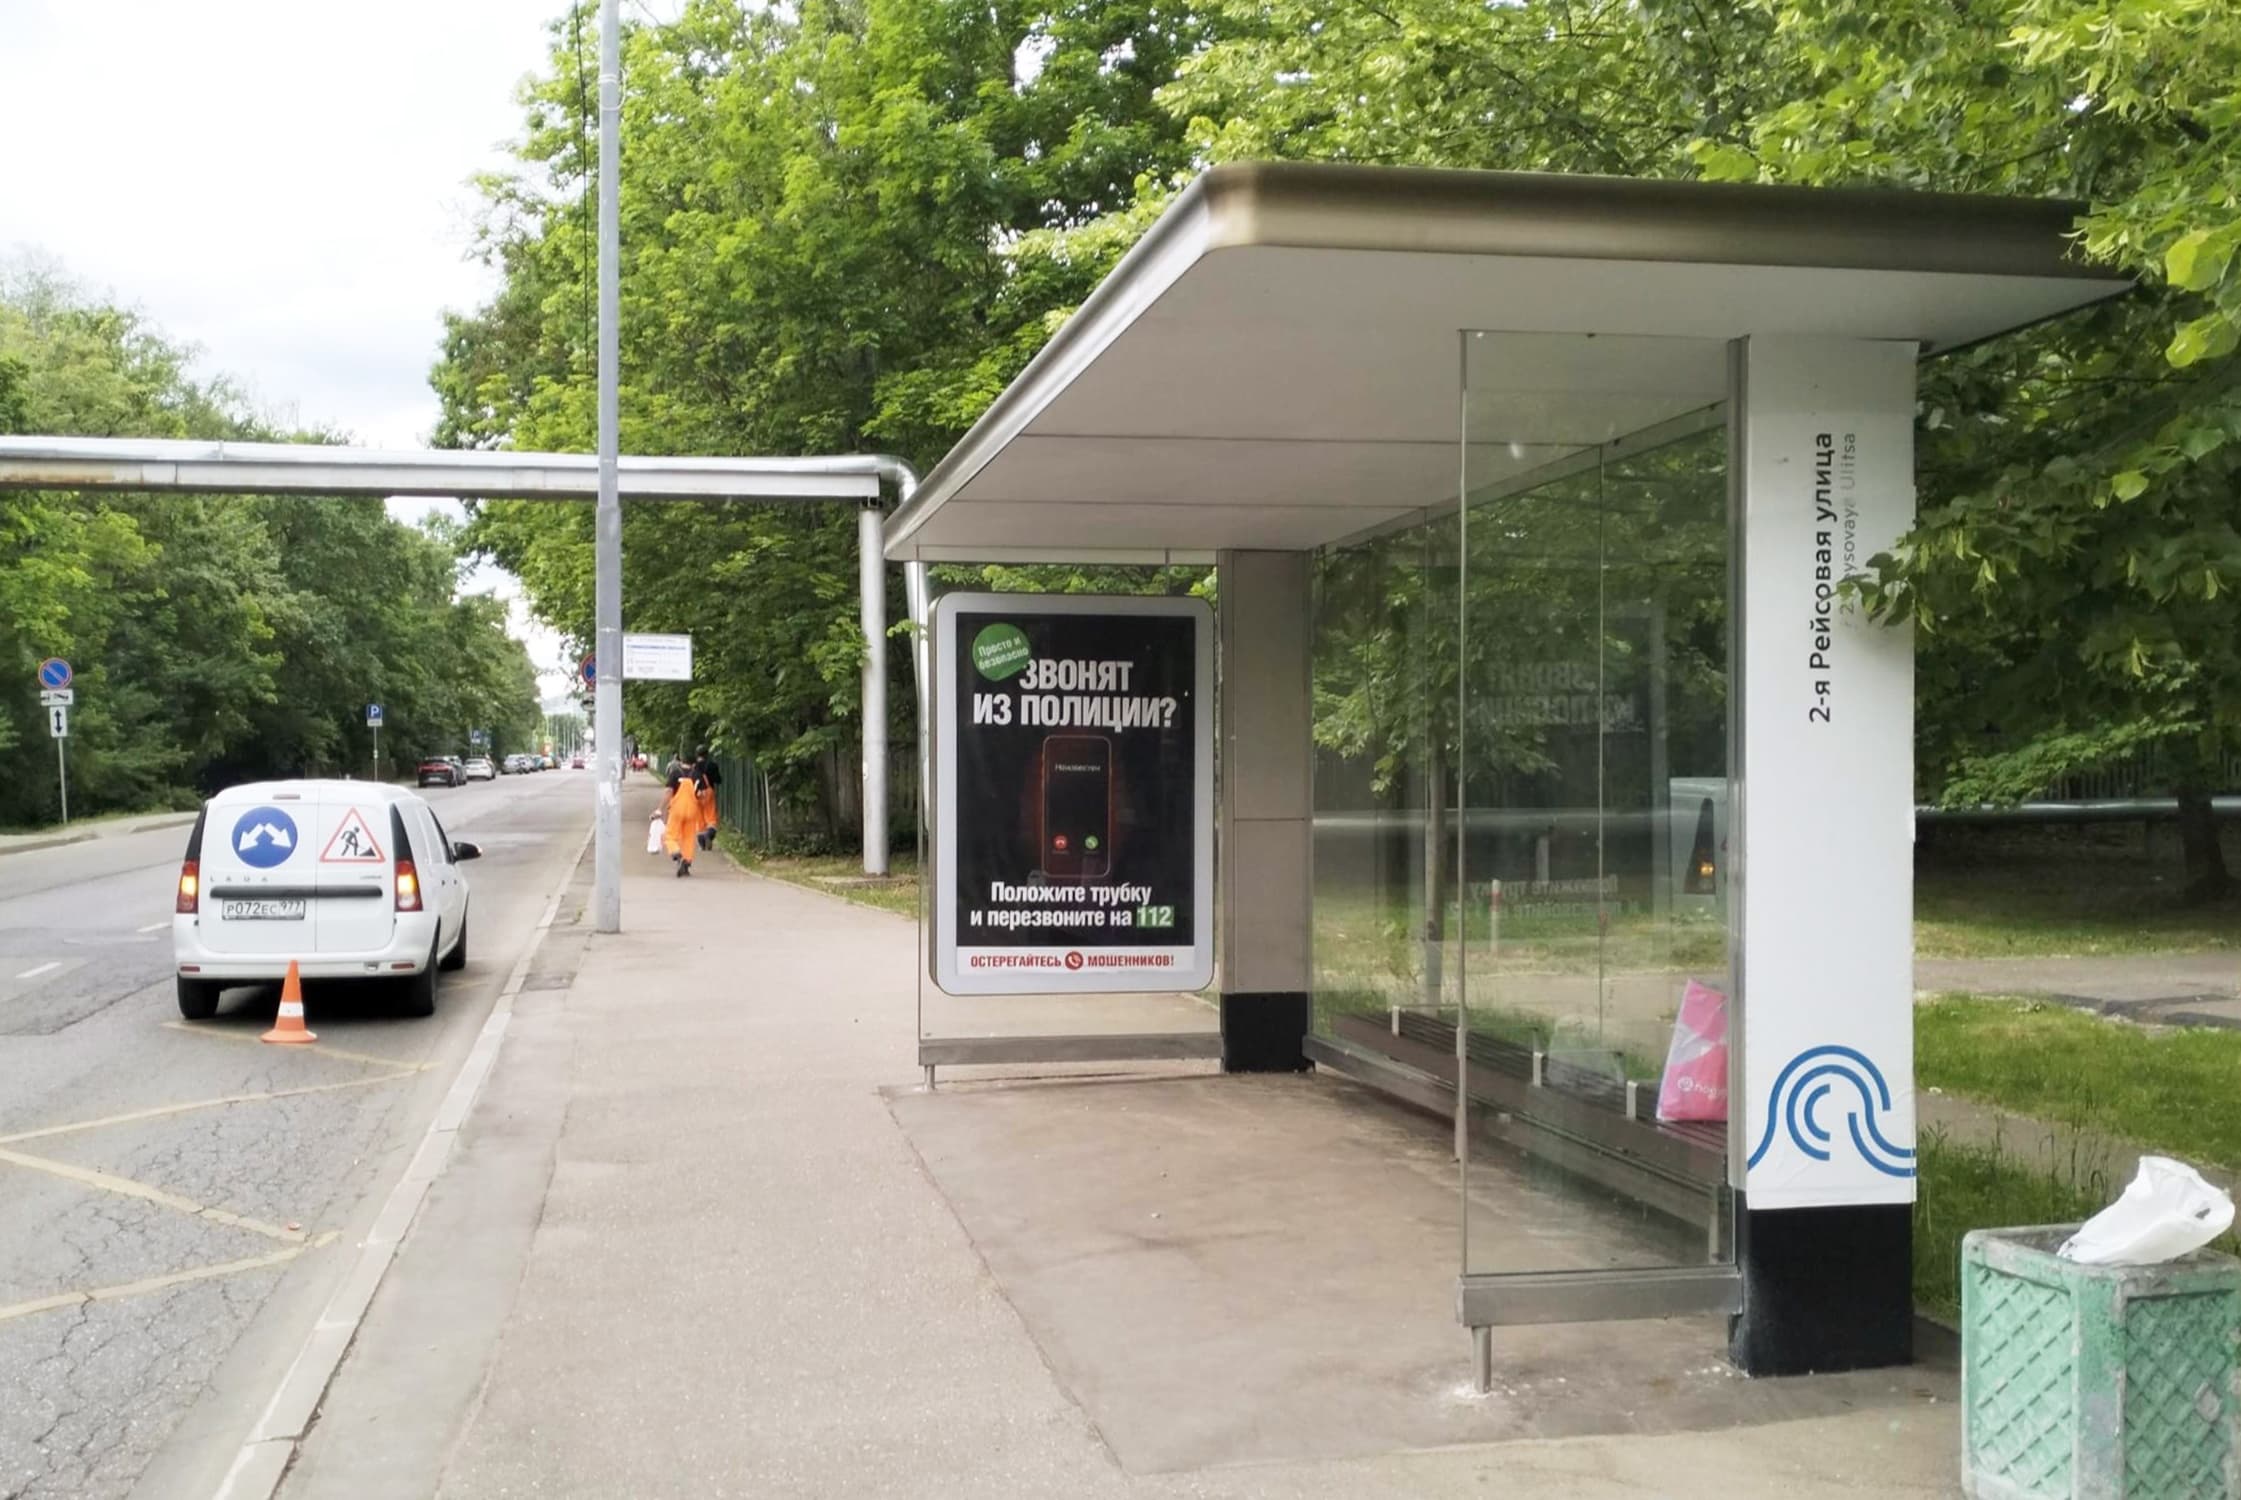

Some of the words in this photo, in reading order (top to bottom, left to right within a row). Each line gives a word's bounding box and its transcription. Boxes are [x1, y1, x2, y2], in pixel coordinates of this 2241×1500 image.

[1815, 432, 1838, 523] улица
[1809, 531, 1832, 669] Рейсовая
[977, 638, 1013, 657] Просто
[1019, 658, 1134, 692] ЗВОНЯТ
[973, 692, 1013, 726] ИЗ
[1020, 694, 1177, 733] ПОЛИЦИИ?
[1809, 680, 1831, 723] 2-я
[991, 881, 1086, 903] Положите
[1089, 882, 1153, 907] трубку
[970, 909, 983, 926] и
[987, 909, 1105, 931] перезвоните
[1109, 909, 1133, 926] на
[1137, 905, 1173, 927] 112
[970, 953, 1062, 968] ОСТЕРЕГАЙТЕСЬ
[1087, 954, 1175, 967] МОШЕННИКОВ!
